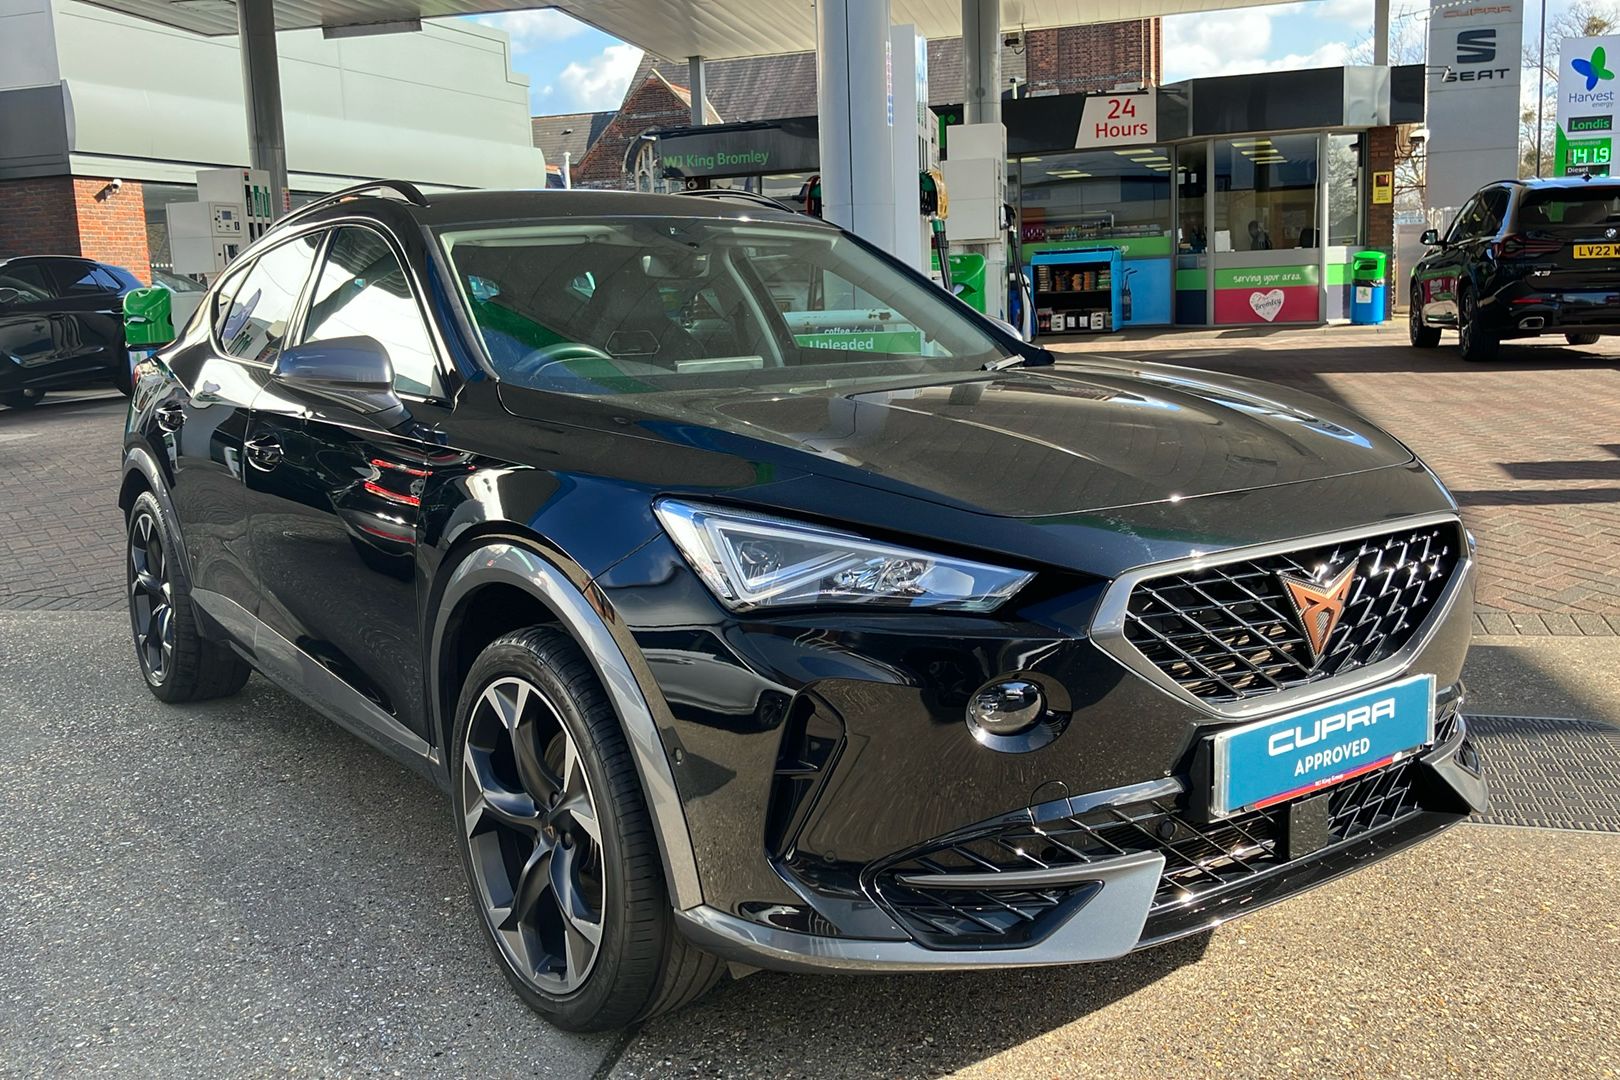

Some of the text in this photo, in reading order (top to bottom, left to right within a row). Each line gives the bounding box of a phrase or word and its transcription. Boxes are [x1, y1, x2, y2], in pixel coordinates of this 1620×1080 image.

[1442, 68, 1511, 82] SEAT
[1568, 91, 1615, 103] Harvest
[1107, 98, 1135, 119] 24
[1095, 122, 1148, 138] Hours
[1571, 119, 1610, 131] Londis
[663, 149, 769, 169] WJ King Bromley
[1579, 246, 1611, 257] LV22
[1233, 275, 1262, 285] serving
[1263, 274, 1280, 285] your
[824, 326, 850, 335] coffee
[1268, 697, 1396, 757] CUPRA
[1294, 737, 1371, 777] APPROVED
